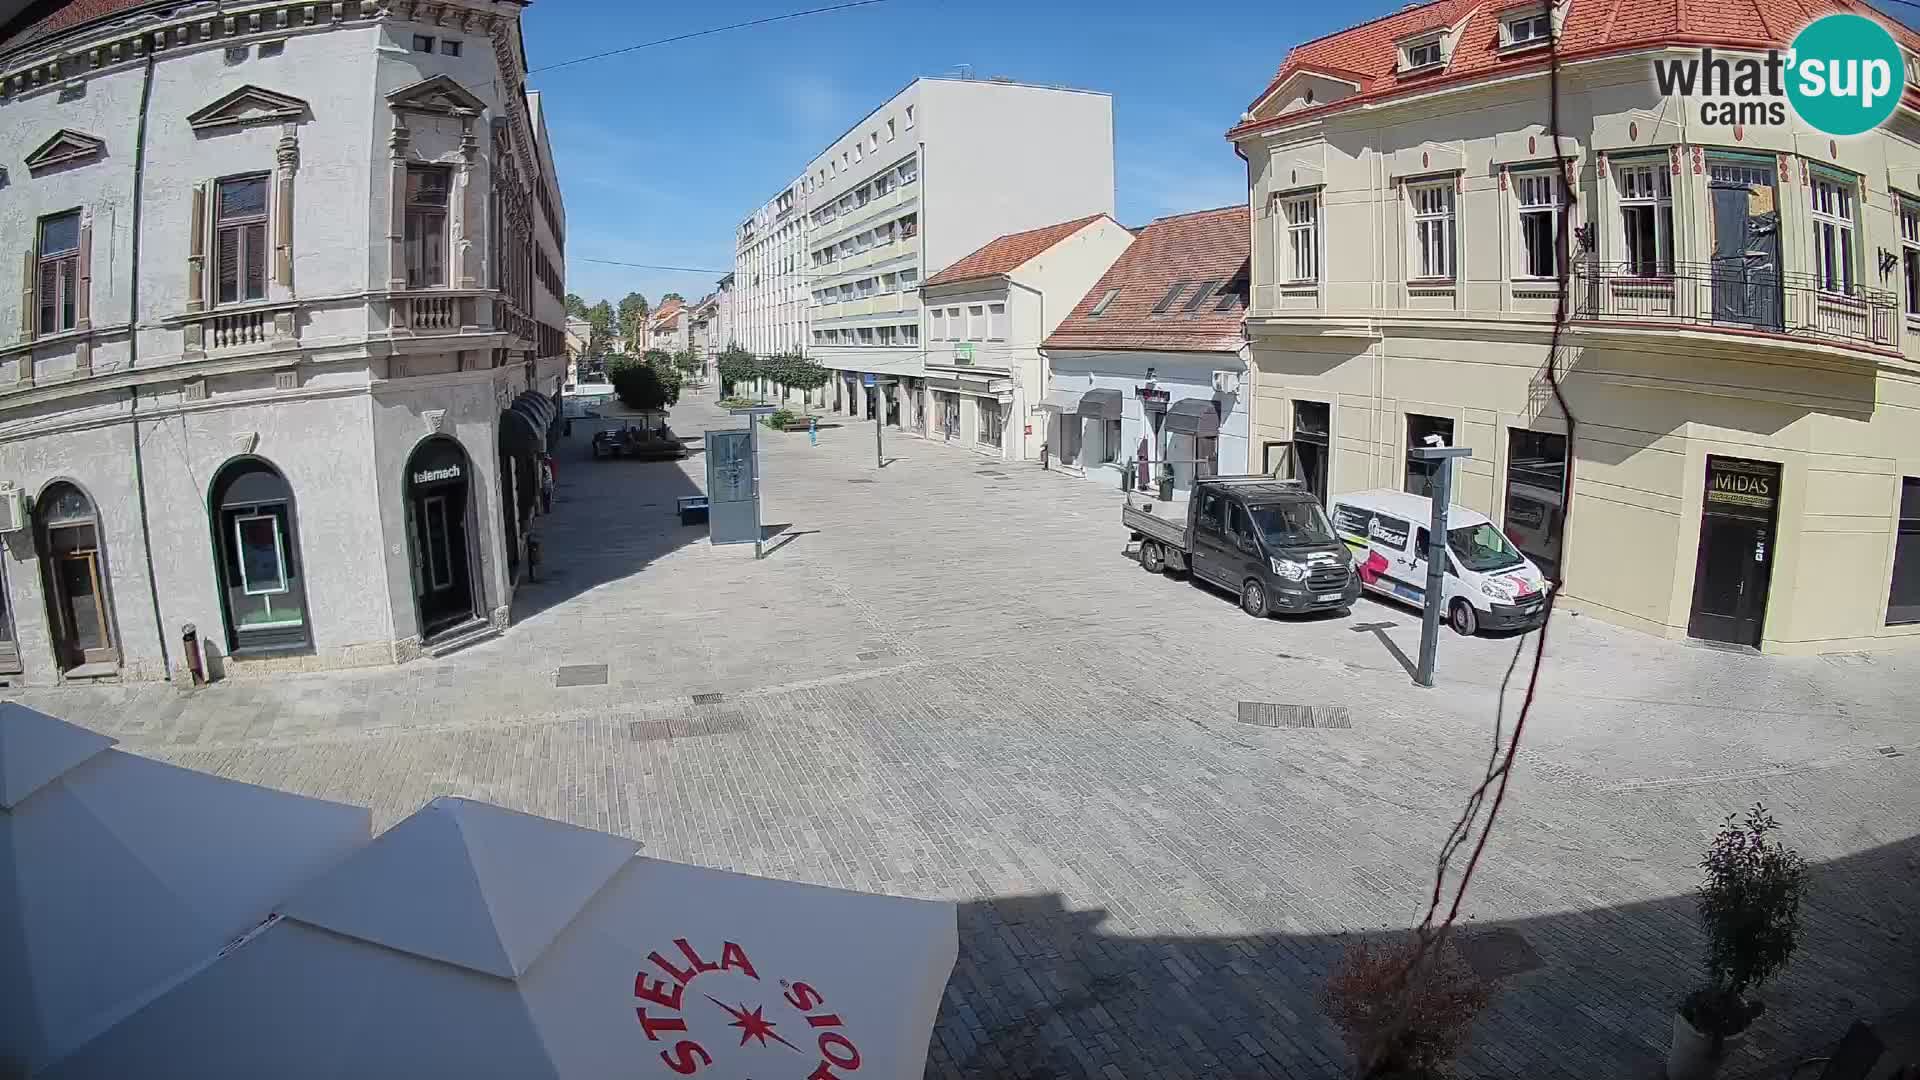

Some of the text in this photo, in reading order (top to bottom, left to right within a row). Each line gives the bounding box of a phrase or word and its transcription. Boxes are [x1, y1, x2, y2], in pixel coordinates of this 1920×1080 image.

[414, 464, 460, 484] telemach
[1715, 472, 1769, 494] MIDAS
[634, 937, 760, 1075] STELLA
